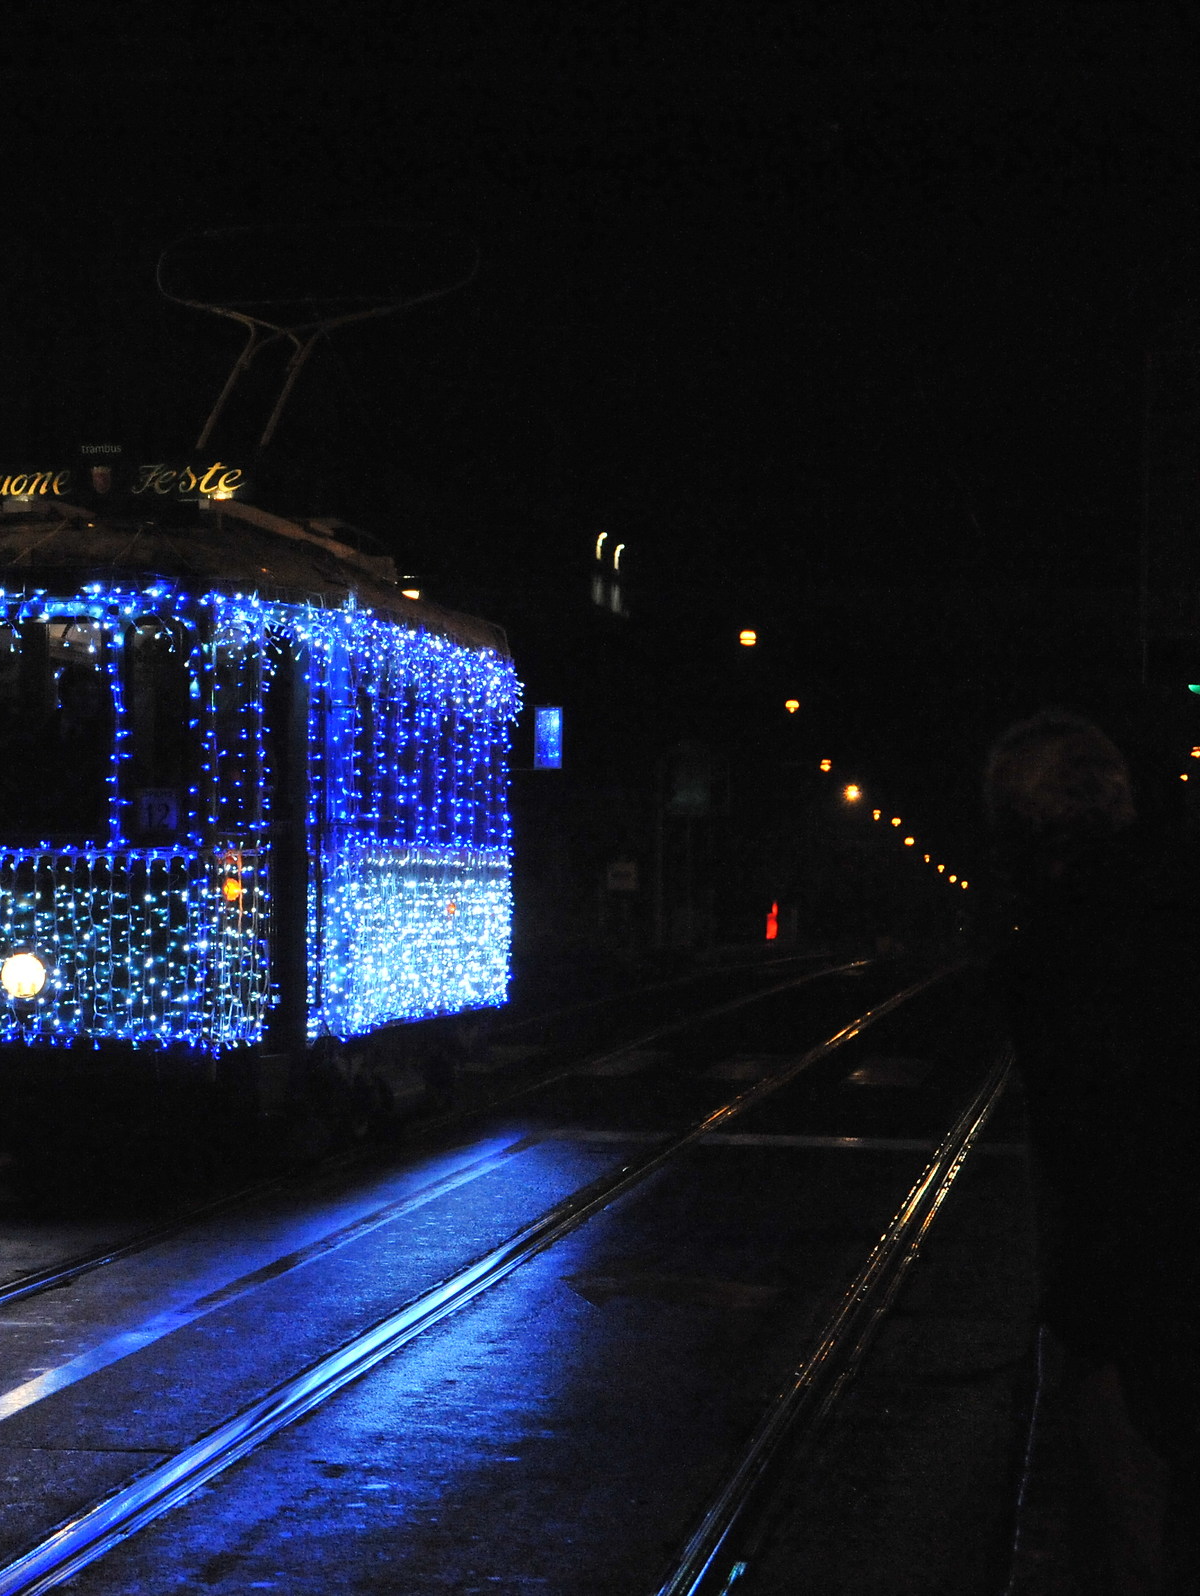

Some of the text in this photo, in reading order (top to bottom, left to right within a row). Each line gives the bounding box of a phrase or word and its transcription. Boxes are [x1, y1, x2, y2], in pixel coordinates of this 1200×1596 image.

[81, 445, 122, 454] trambus
[131, 461, 248, 496] Feste
[147, 803, 170, 829] 12
